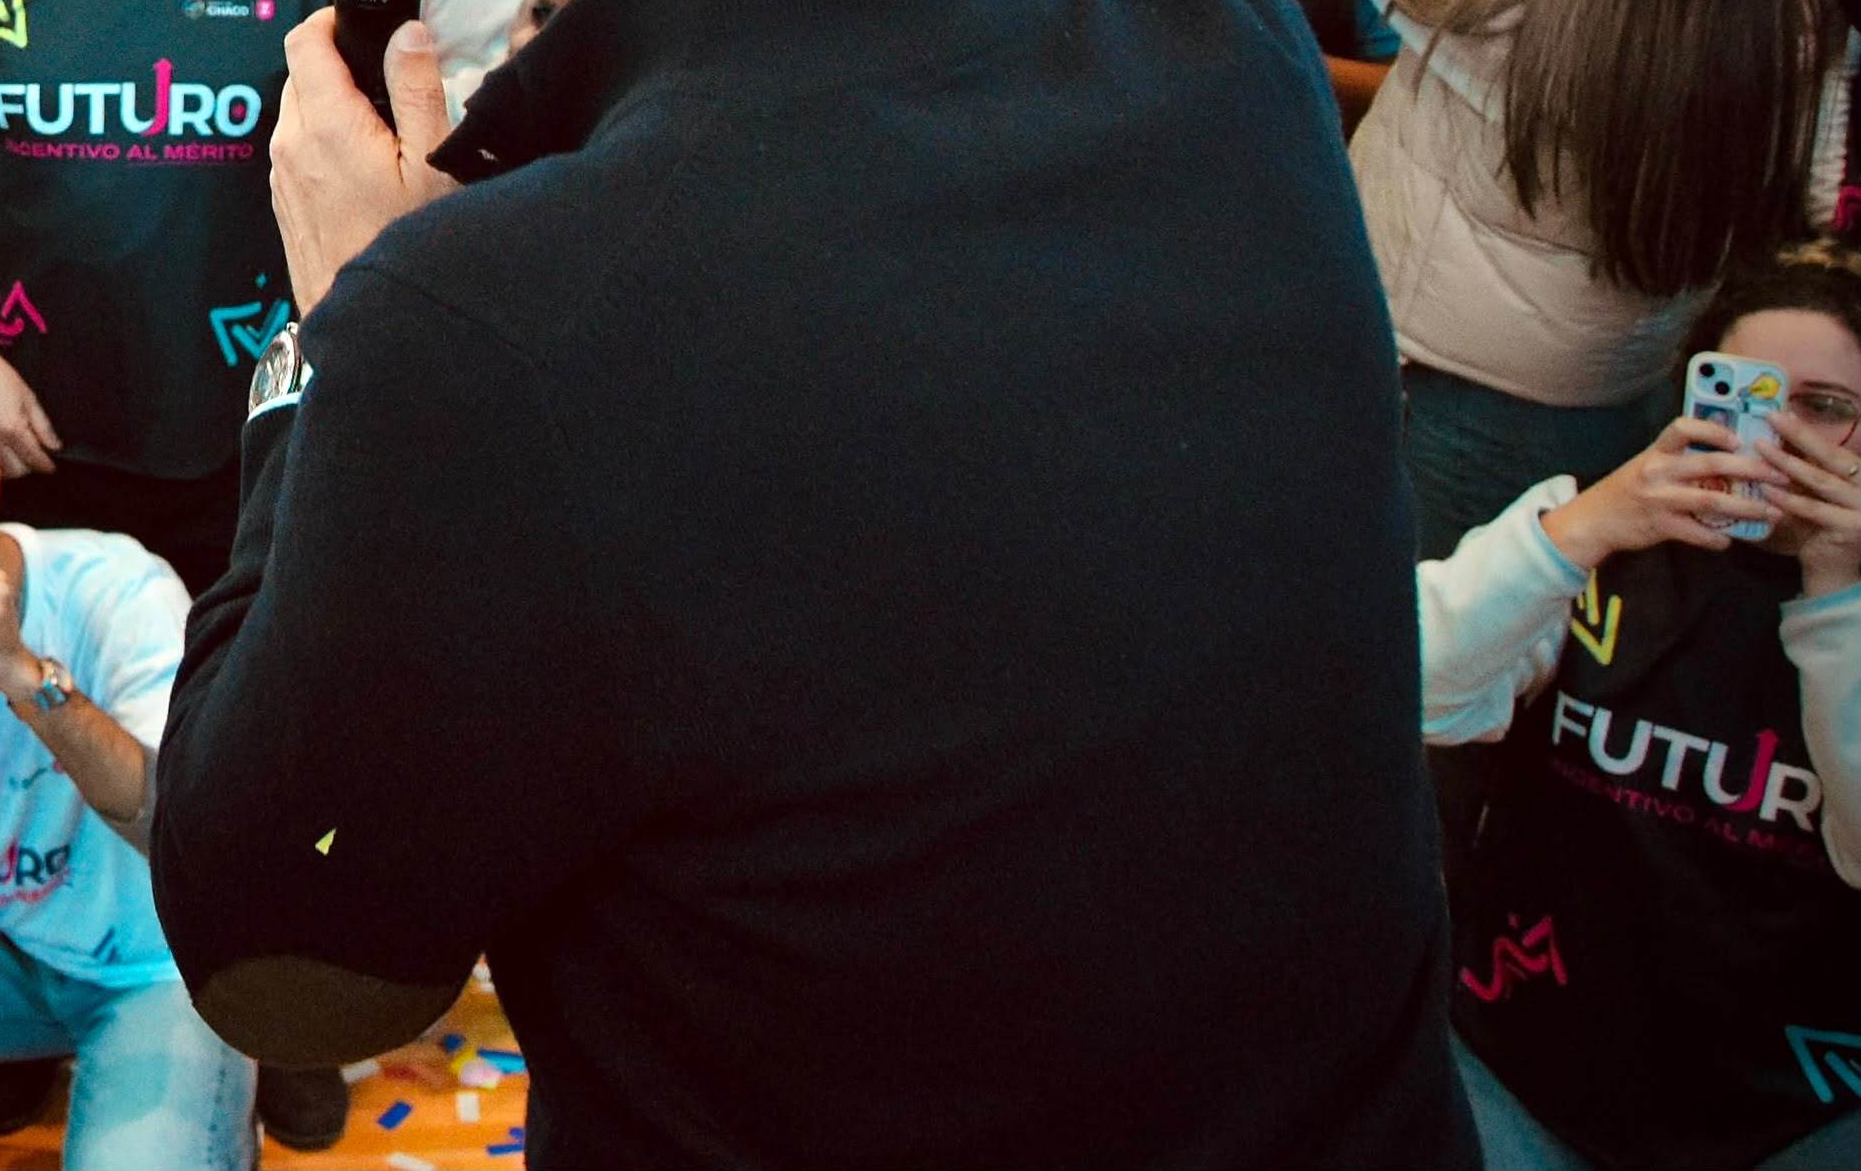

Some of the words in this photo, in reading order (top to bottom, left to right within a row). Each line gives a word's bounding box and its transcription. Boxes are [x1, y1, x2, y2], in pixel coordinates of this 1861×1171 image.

[6, 137, 121, 161] INCENTIVO
[125, 143, 158, 161] AL
[1551, 689, 1823, 832] FUTUR
